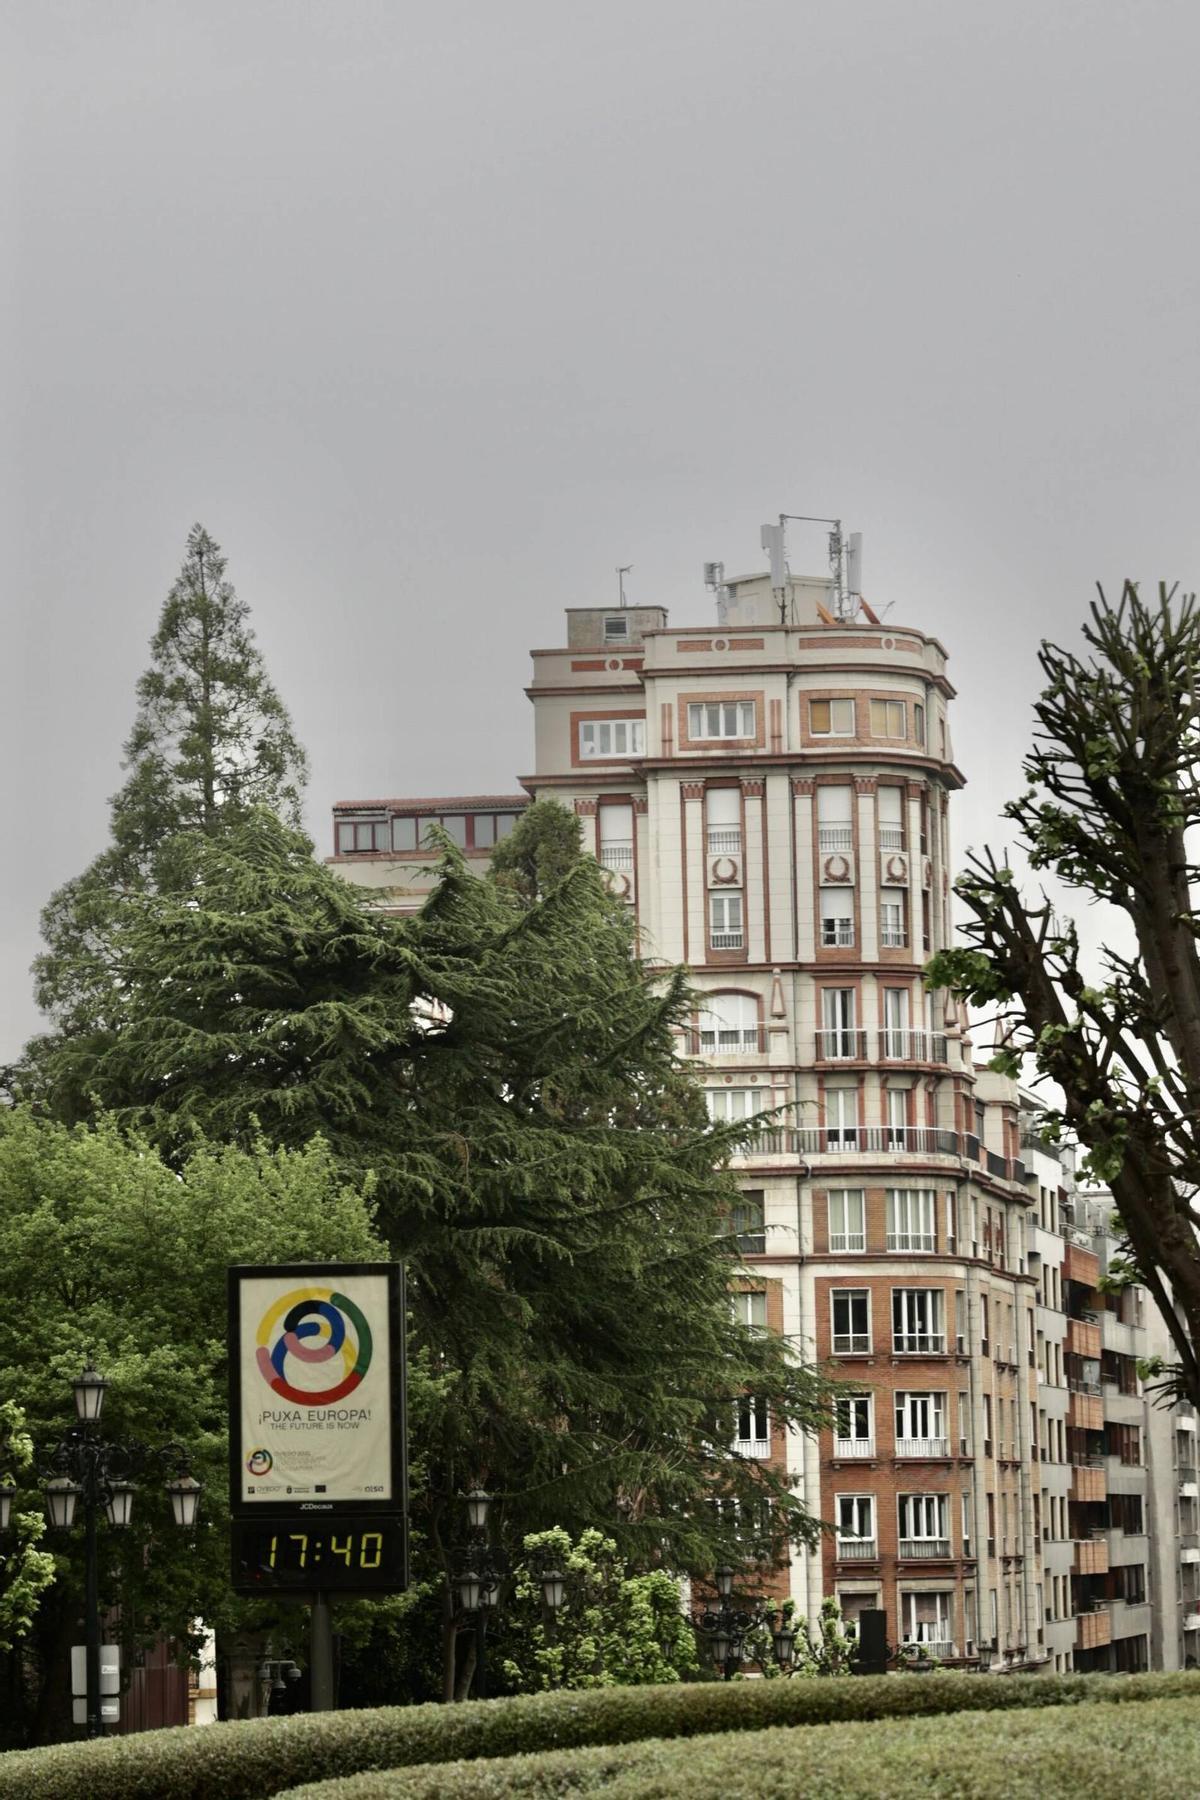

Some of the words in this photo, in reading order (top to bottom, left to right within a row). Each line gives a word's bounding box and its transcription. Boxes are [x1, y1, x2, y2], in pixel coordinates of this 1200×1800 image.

[259, 1410, 301, 1424] ¡PUXA
[307, 1409, 371, 1421] EUROPA!
[270, 1422, 287, 1430] THE
[290, 1422, 324, 1430] FUTURE
[326, 1422, 335, 1430] IS
[337, 1421, 360, 1430] NOW
[269, 1533, 382, 1568] 17:40
